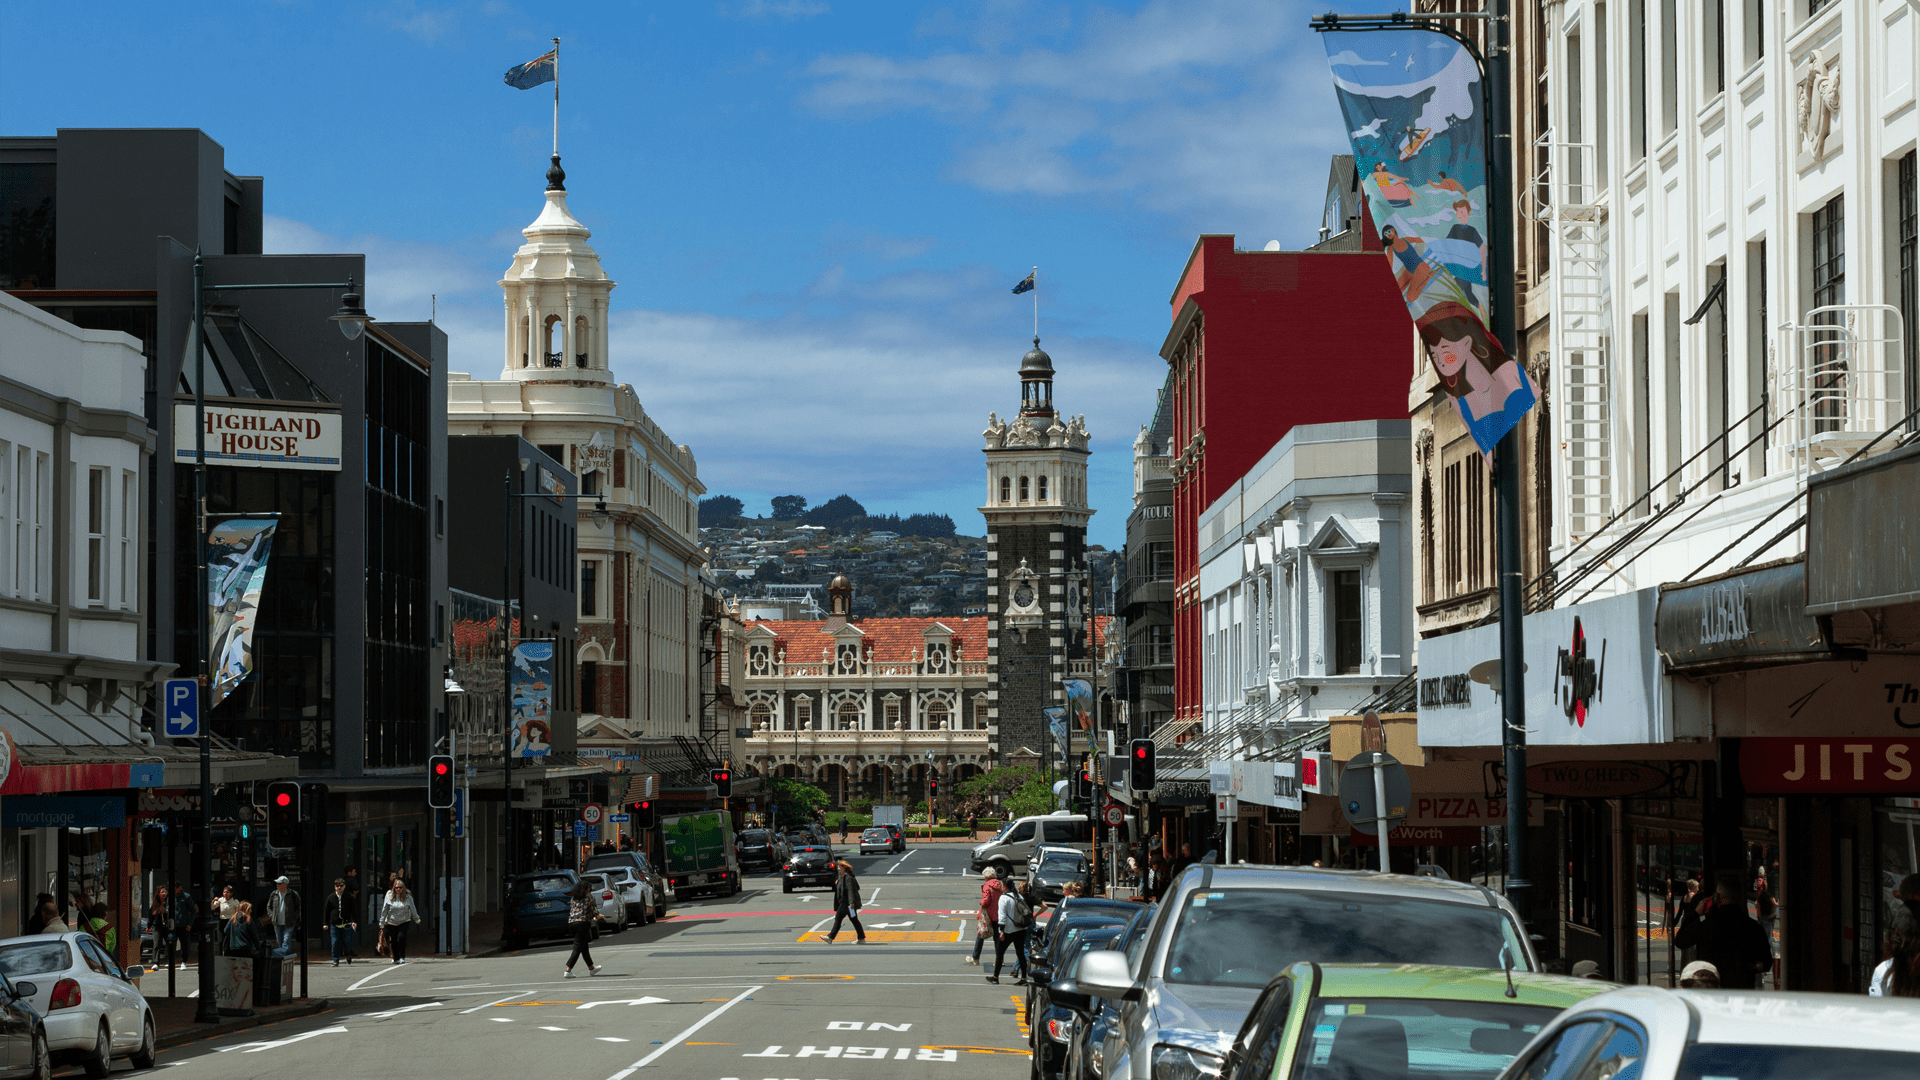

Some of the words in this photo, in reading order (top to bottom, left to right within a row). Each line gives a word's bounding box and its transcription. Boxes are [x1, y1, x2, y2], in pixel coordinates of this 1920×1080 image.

[220, 432, 299, 457] HOUSE
[1700, 579, 1749, 645] ALBAR
[174, 687, 189, 706] P
[1782, 744, 1912, 781] JITS
[1542, 767, 1579, 782] TWO
[1585, 768, 1640, 782] CHEFS
[587, 810, 598, 818] 50
[1109, 811, 1122, 822] 50
[1418, 798, 1480, 818] PIZZA
[16, 812, 75, 826] mortgage
[826, 1020, 913, 1032] NO
[742, 1045, 957, 1062] RIGHT
